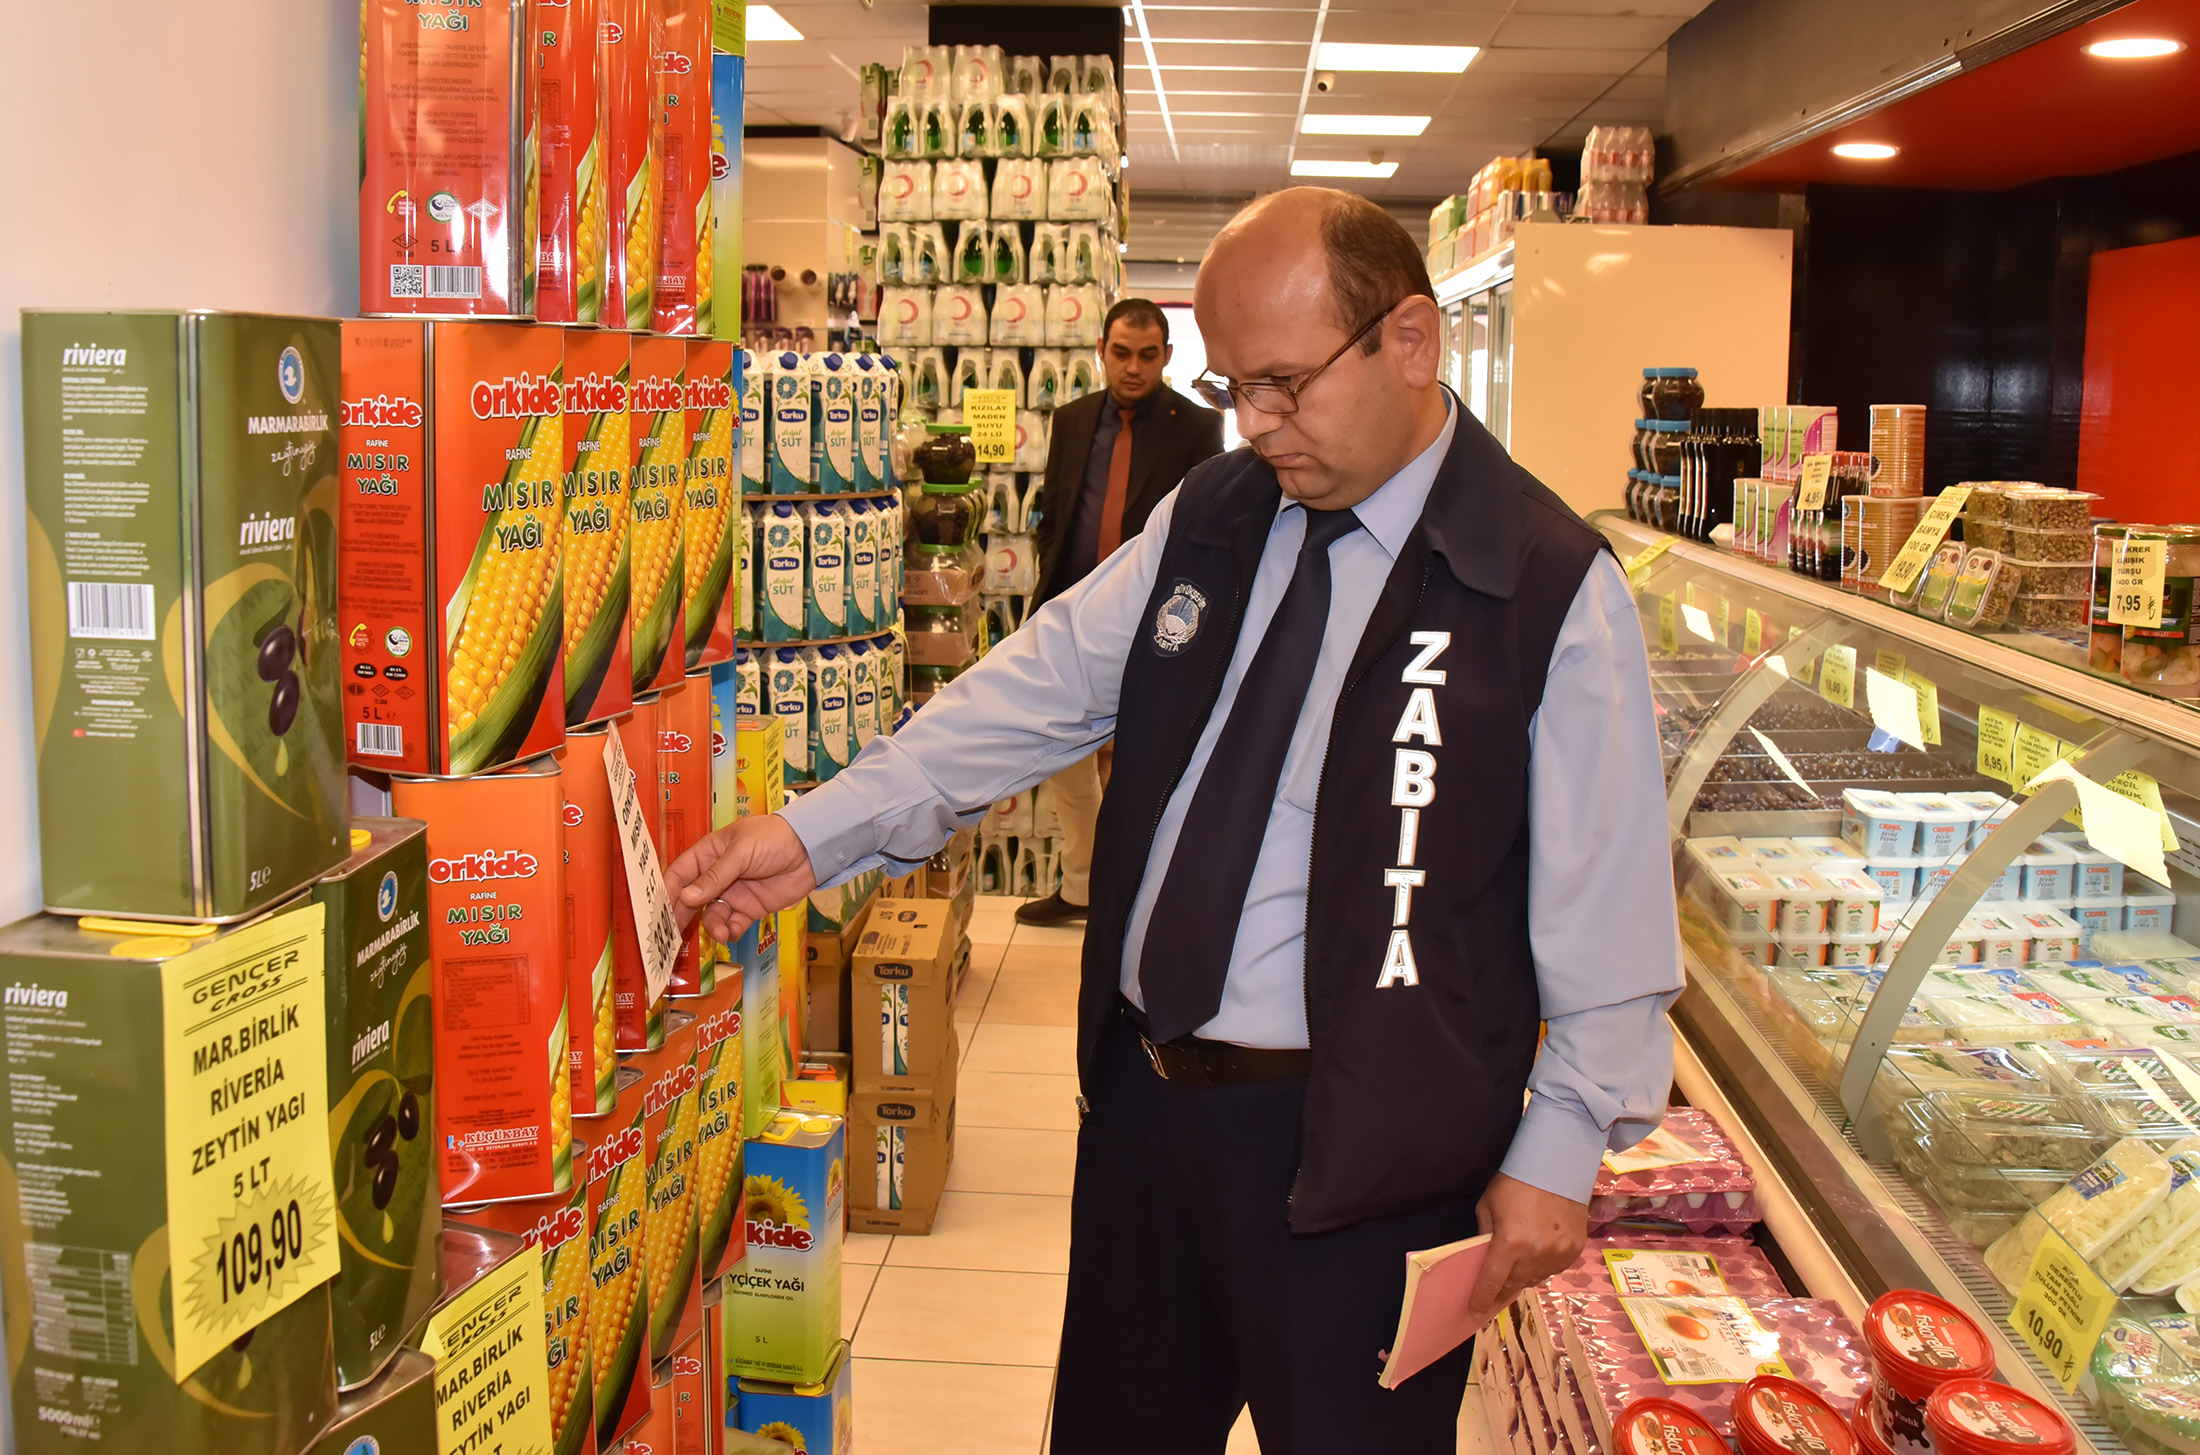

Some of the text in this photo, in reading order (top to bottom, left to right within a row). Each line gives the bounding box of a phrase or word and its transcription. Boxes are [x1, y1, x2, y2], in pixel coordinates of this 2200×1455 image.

[417, 9, 469, 32] YAĞI
[431, 240, 439, 252] 5
[62, 343, 127, 366] riviera
[563, 371, 628, 420] rkide
[630, 370, 684, 414] rkide
[685, 373, 730, 411] rkide
[248, 409, 329, 434] MARMARABİRLİK
[780, 411, 805, 421] Torku
[829, 411, 847, 420] Torku
[366, 438, 389, 448] RAFİNE
[577, 439, 600, 454] RAFİNE
[638, 436, 660, 449] RAFİNE
[692, 432, 711, 443] RAFİNE
[781, 435, 801, 447] SÜT
[830, 435, 846, 447] SÜT
[347, 453, 409, 472] MISIR
[505, 445, 531, 462] RAFİNE
[977, 443, 1005, 460] 14,90
[357, 474, 399, 496] YAĞI
[563, 469, 621, 498] MISIR
[481, 479, 554, 512] MISIR
[632, 491, 670, 523] YAĞI
[685, 480, 719, 512] YAĞI
[239, 511, 295, 546] riviera
[569, 500, 611, 534] YAĞI
[495, 515, 543, 552] YAĞI
[1919, 543, 1931, 553] GR
[772, 559, 797, 568] Torku
[817, 558, 838, 567] Torku
[2118, 568, 2142, 576] TURŞU
[773, 583, 794, 595] SÜT
[819, 581, 836, 592] SÜT
[2117, 595, 2141, 614] 7,95
[737, 704, 753, 713] rku
[776, 702, 801, 713] Torku
[823, 699, 843, 709] Torku
[856, 694, 872, 703] Torku
[362, 706, 382, 720] 5 L
[785, 726, 799, 738] ÜT
[825, 724, 841, 735] SÜT
[1984, 753, 2002, 772] 8,95
[736, 796, 750, 804] sır
[1375, 631, 1452, 989] ZABITA
[470, 890, 497, 902] RAFİNE
[447, 904, 523, 924] MISIR
[356, 909, 420, 969] MARMARABİRLİK
[459, 923, 511, 946] YAĞI
[193, 949, 299, 1005] GENÇER
[878, 965, 910, 978] Torku
[5, 981, 68, 1009] riviera
[210, 973, 282, 1013] CROSS
[193, 1003, 300, 1077] MAR.BİRLİK
[351, 1019, 390, 1067] riviera
[697, 1010, 741, 1054] kide
[699, 1065, 719, 1082] RAFİNE
[210, 1057, 285, 1116] RİVERİA
[644, 1064, 697, 1119] rkide
[699, 1080, 737, 1114] ISIR
[880, 1105, 912, 1118] Torku
[192, 1091, 306, 1176] ZEYTİN YAGI
[464, 1126, 539, 1145] KÜÇÜKBAY
[656, 1126, 676, 1144] RAFİNE
[587, 1126, 643, 1187] rkide
[233, 1156, 271, 1199] 5 LT
[597, 1192, 620, 1214] RAFİNE
[651, 1172, 686, 1213] YAĞI
[746, 1218, 815, 1251] kide
[216, 1199, 302, 1305] 109,90
[591, 1247, 632, 1289] YAĞI
[755, 1267, 772, 1275] RAFİNE
[729, 1273, 805, 1293] YÇİÇEK YAĞI
[2046, 1270, 2080, 1309] TAM YAĞLI
[2049, 1263, 2083, 1301] DEREOTLU
[754, 1292, 785, 1301] SUNFLOWER
[2034, 1269, 2084, 1326] TULUM PEYNİRİ
[2043, 1291, 2067, 1319] 300 GR
[448, 1307, 508, 1360] CROSS
[755, 1335, 769, 1344] 5 L
[1914, 1313, 1956, 1360] fiskorella
[2028, 1308, 2063, 1359] 10,90
[436, 1323, 524, 1409] MAR.BİRLİK
[452, 1368, 513, 1432] RİVERİA
[497, 1386, 531, 1427] YAGI
[1781, 1400, 1827, 1451] fiskorella
[1982, 1400, 2037, 1439] fiskorella
[1663, 1424, 1685, 1455] fiskor
